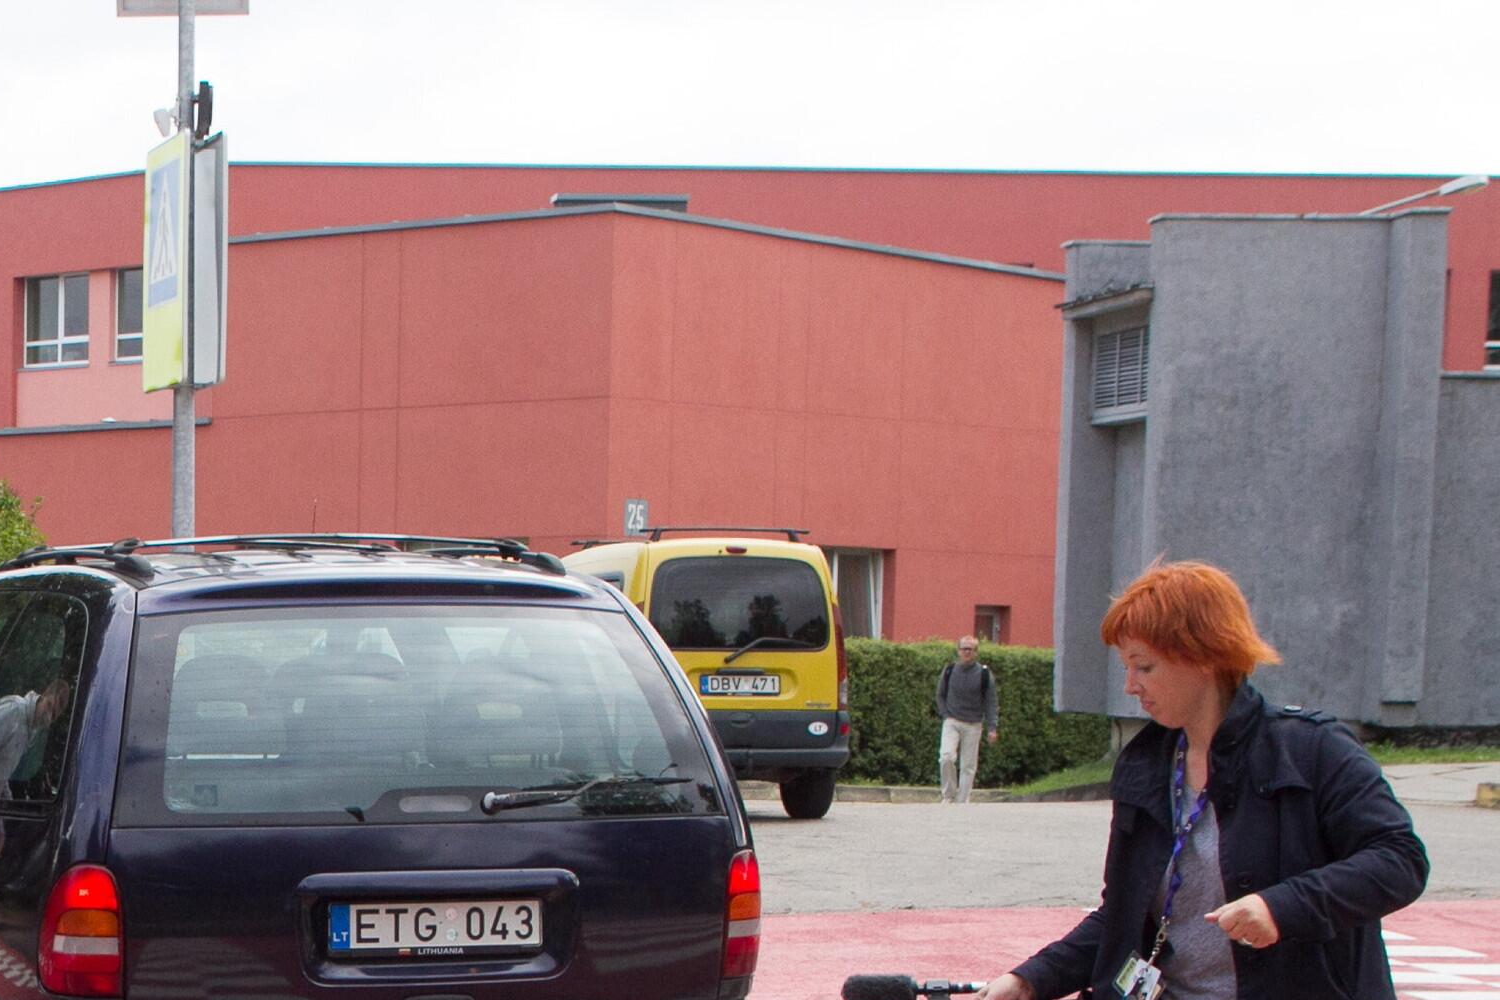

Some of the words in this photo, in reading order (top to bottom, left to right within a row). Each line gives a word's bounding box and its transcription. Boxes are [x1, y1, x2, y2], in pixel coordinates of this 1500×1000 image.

[628, 504, 644, 529] 25
[710, 677, 741, 691] DBV
[752, 677, 776, 691] 471
[355, 907, 438, 944] ETG
[466, 905, 534, 941] 043
[333, 932, 349, 942] LT
[418, 947, 464, 955] LITHUANIA
